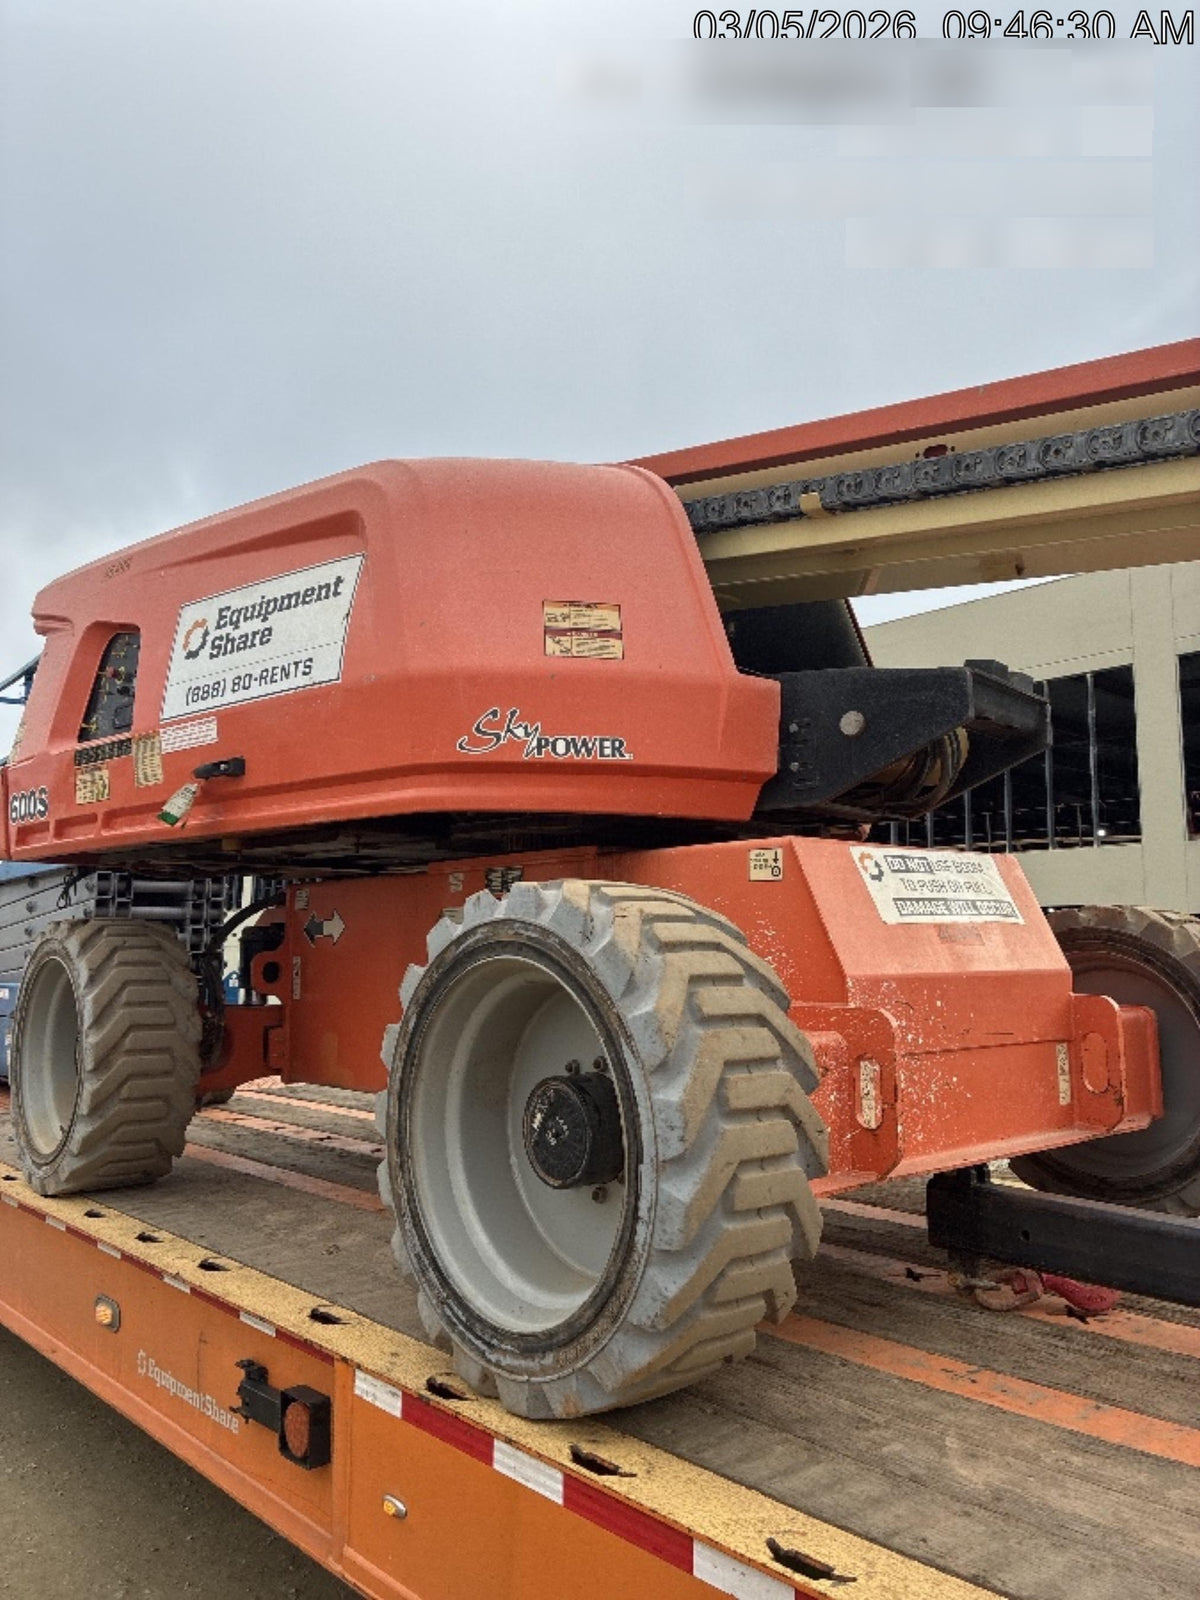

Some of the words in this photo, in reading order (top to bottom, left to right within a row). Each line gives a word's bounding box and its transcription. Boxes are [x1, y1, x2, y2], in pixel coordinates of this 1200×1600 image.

[214, 575, 345, 631] Equipment
[208, 626, 273, 660] Share
[185, 679, 227, 706] (888)
[10, 787, 48, 823] 600S
[148, 1358, 239, 1434] EquipmentShare
